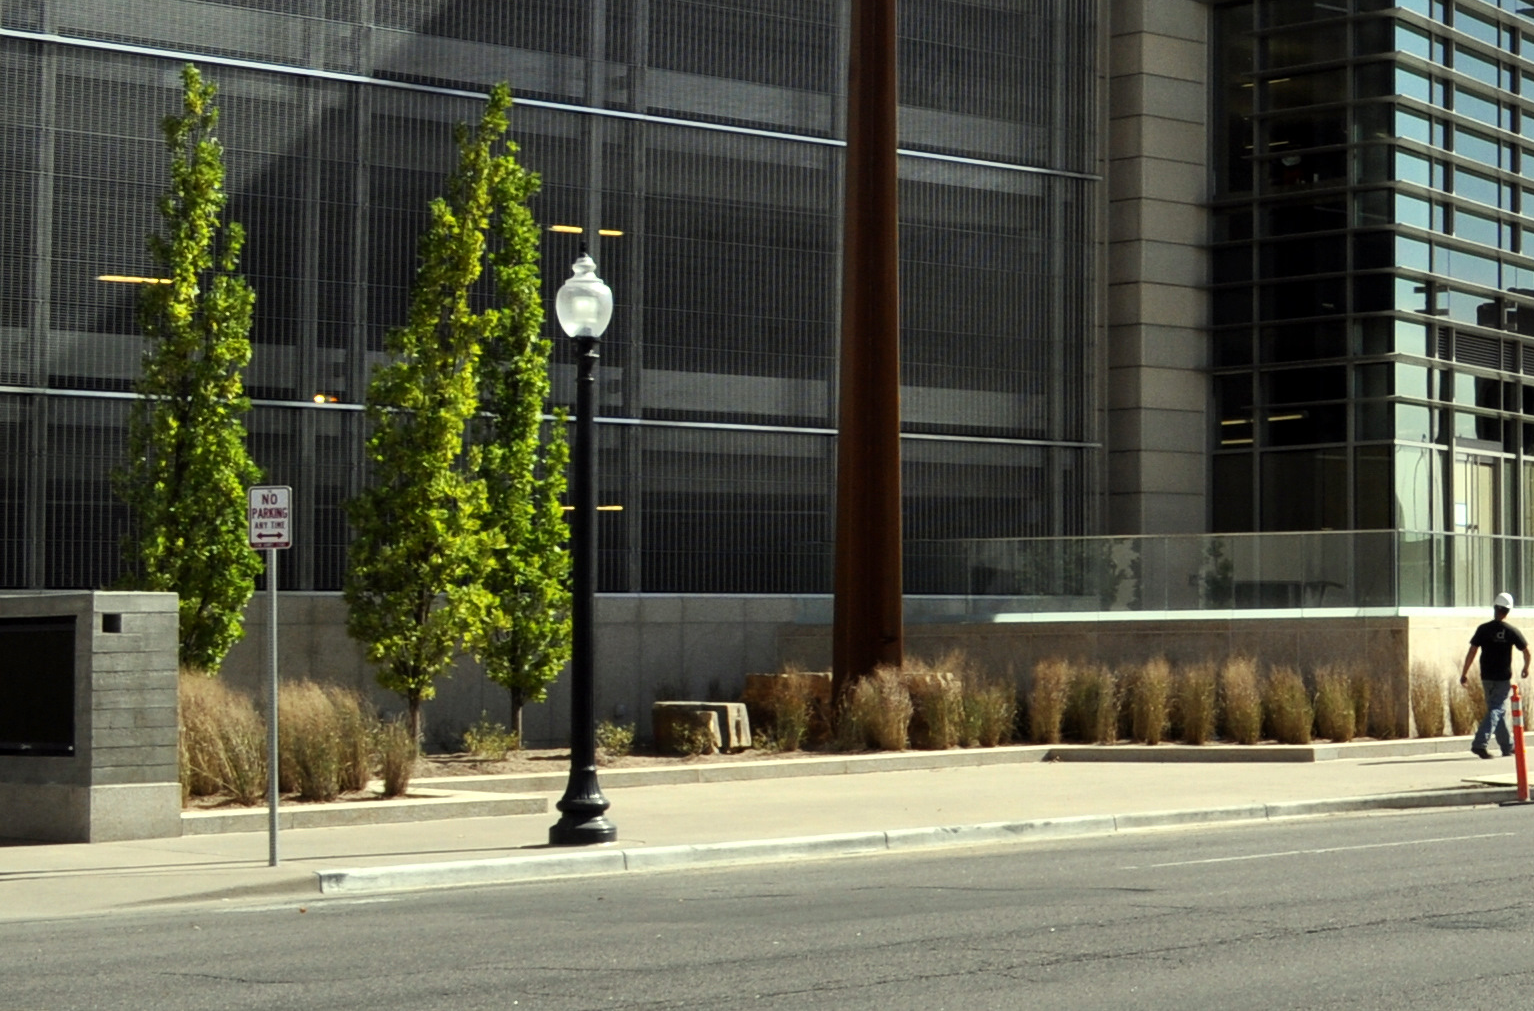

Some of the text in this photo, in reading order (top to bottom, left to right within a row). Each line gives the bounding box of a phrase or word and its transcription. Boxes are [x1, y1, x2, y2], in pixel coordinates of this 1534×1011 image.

[261, 493, 278, 505] NO
[252, 507, 288, 519] PARKING
[271, 521, 285, 529] TIME
